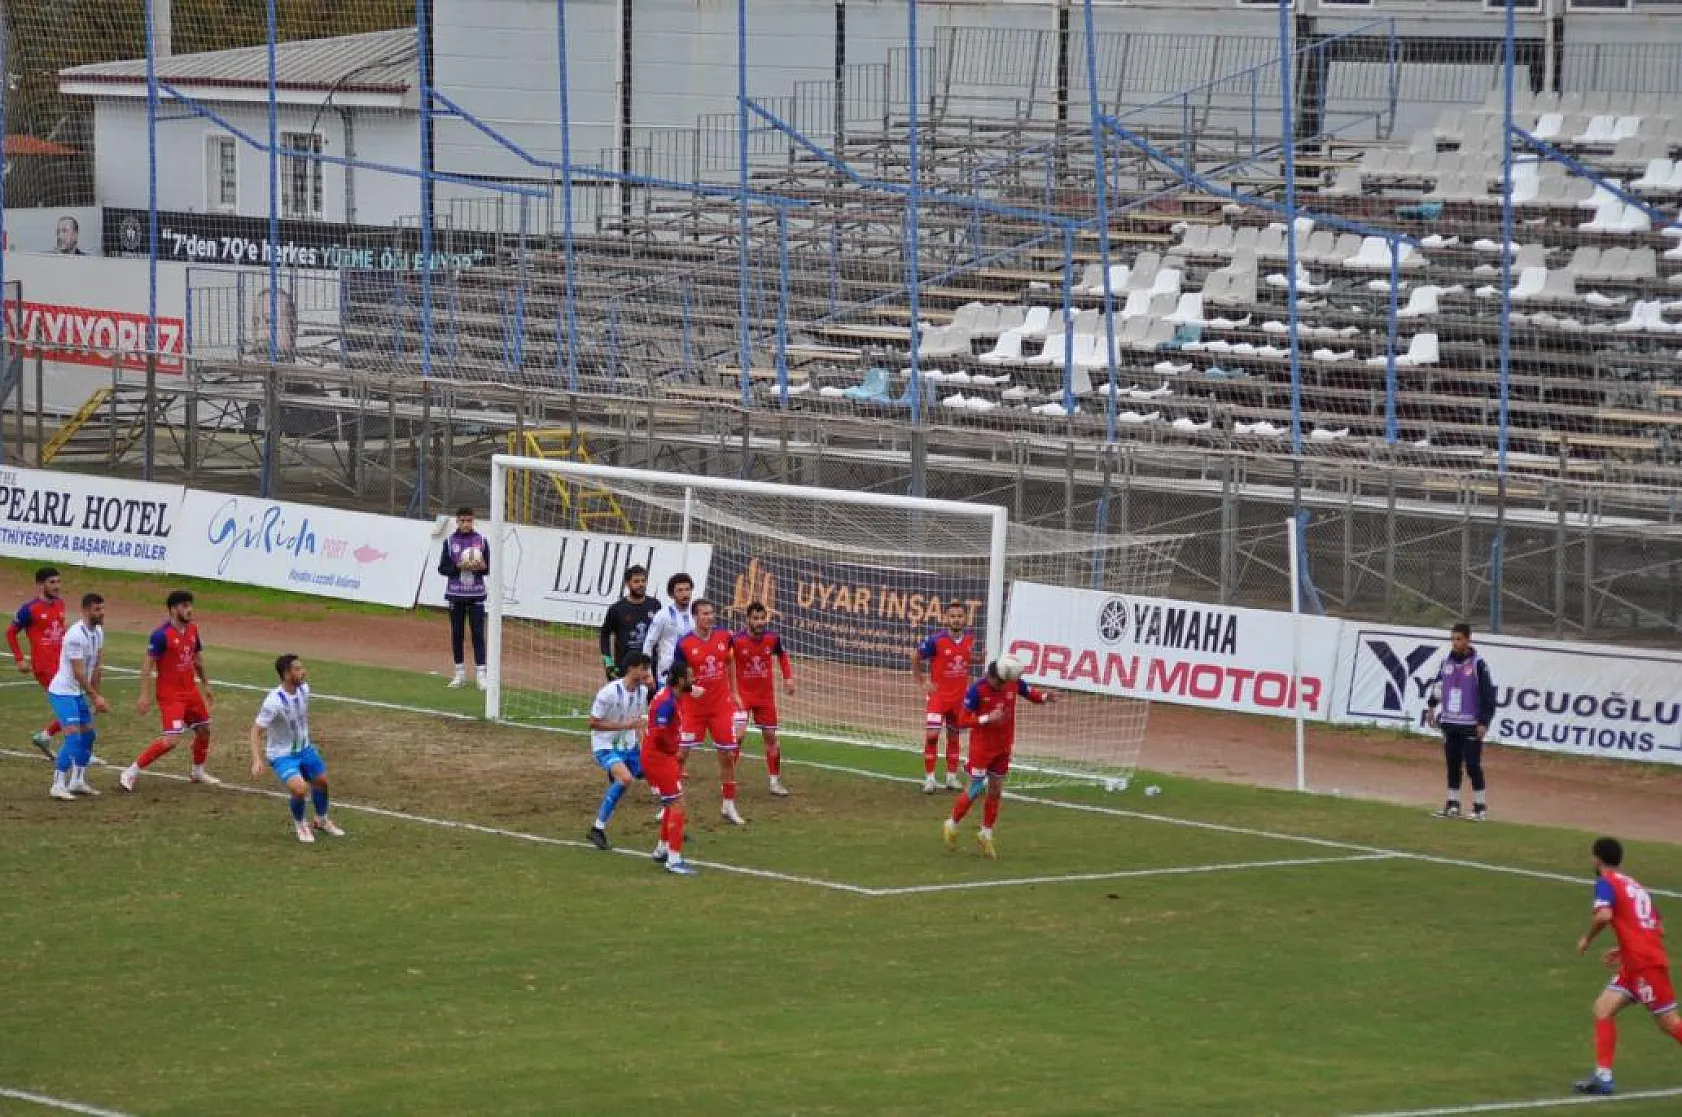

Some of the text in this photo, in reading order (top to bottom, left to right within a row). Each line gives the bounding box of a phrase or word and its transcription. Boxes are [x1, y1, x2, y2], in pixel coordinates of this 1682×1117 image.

[82, 494, 172, 537] HOTEL
[1134, 603, 1237, 655] YAMAHA
[1009, 639, 1322, 713] ORAN MOTOR
[1500, 717, 1655, 753] SOLUTIONS
